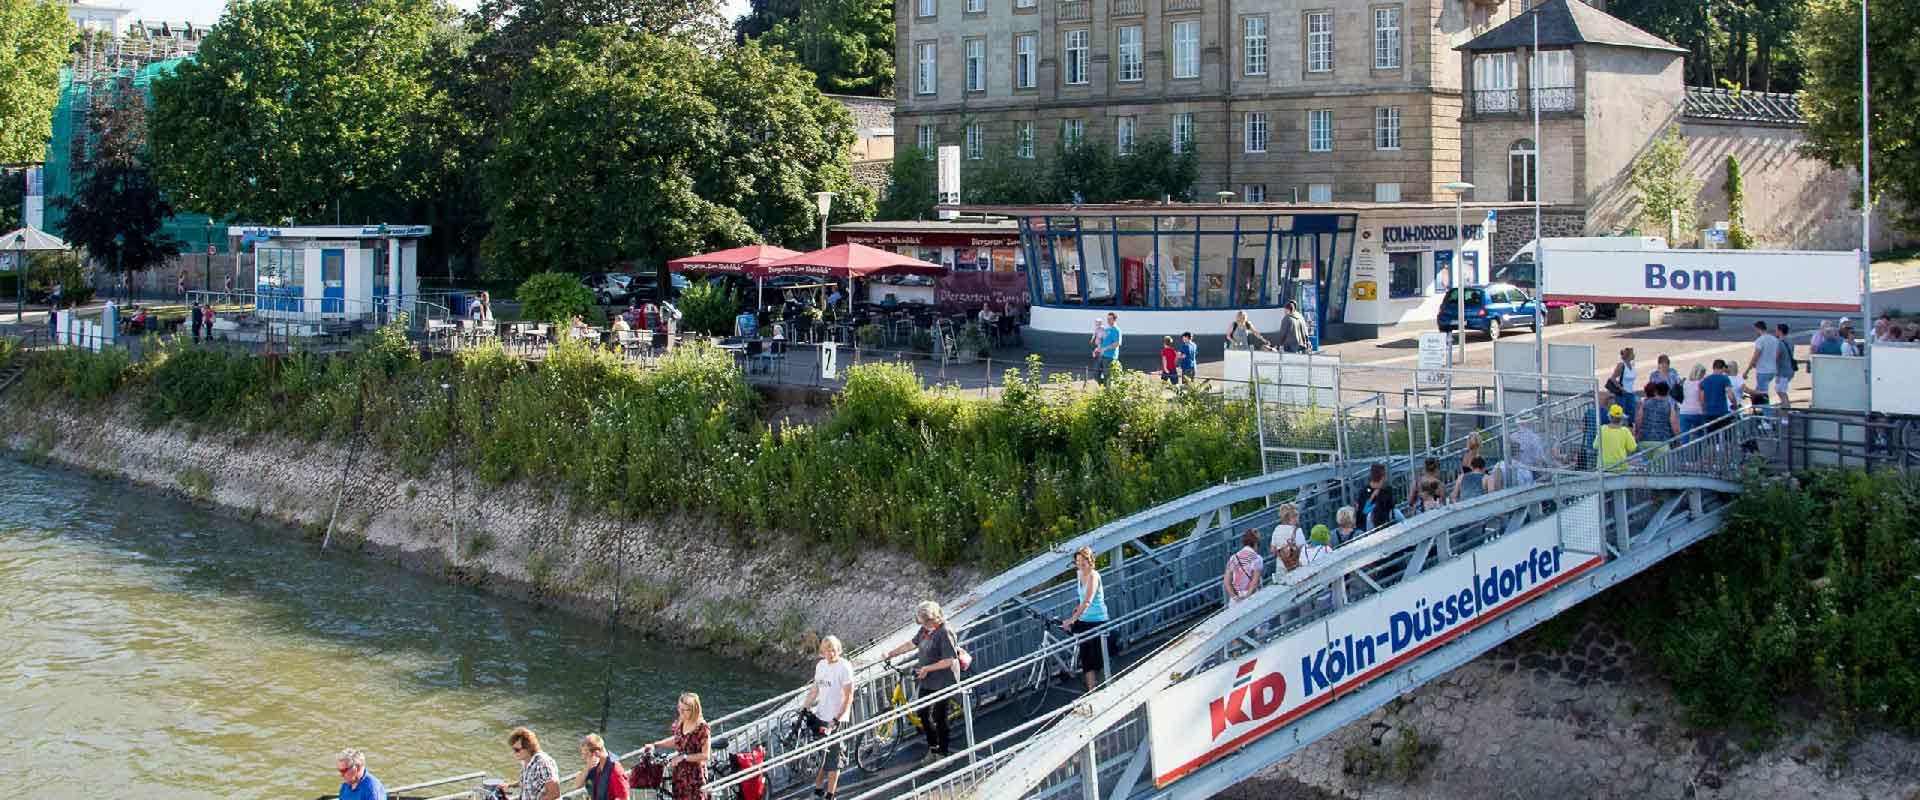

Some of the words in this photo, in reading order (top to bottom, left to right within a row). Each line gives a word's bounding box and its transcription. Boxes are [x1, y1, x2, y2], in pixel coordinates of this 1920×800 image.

[1645, 264, 1736, 291] Bonn
[825, 348, 831, 370] 7
[1209, 671, 1286, 742] KD
[1301, 546, 1564, 698] Köln-Düsseldorfer
